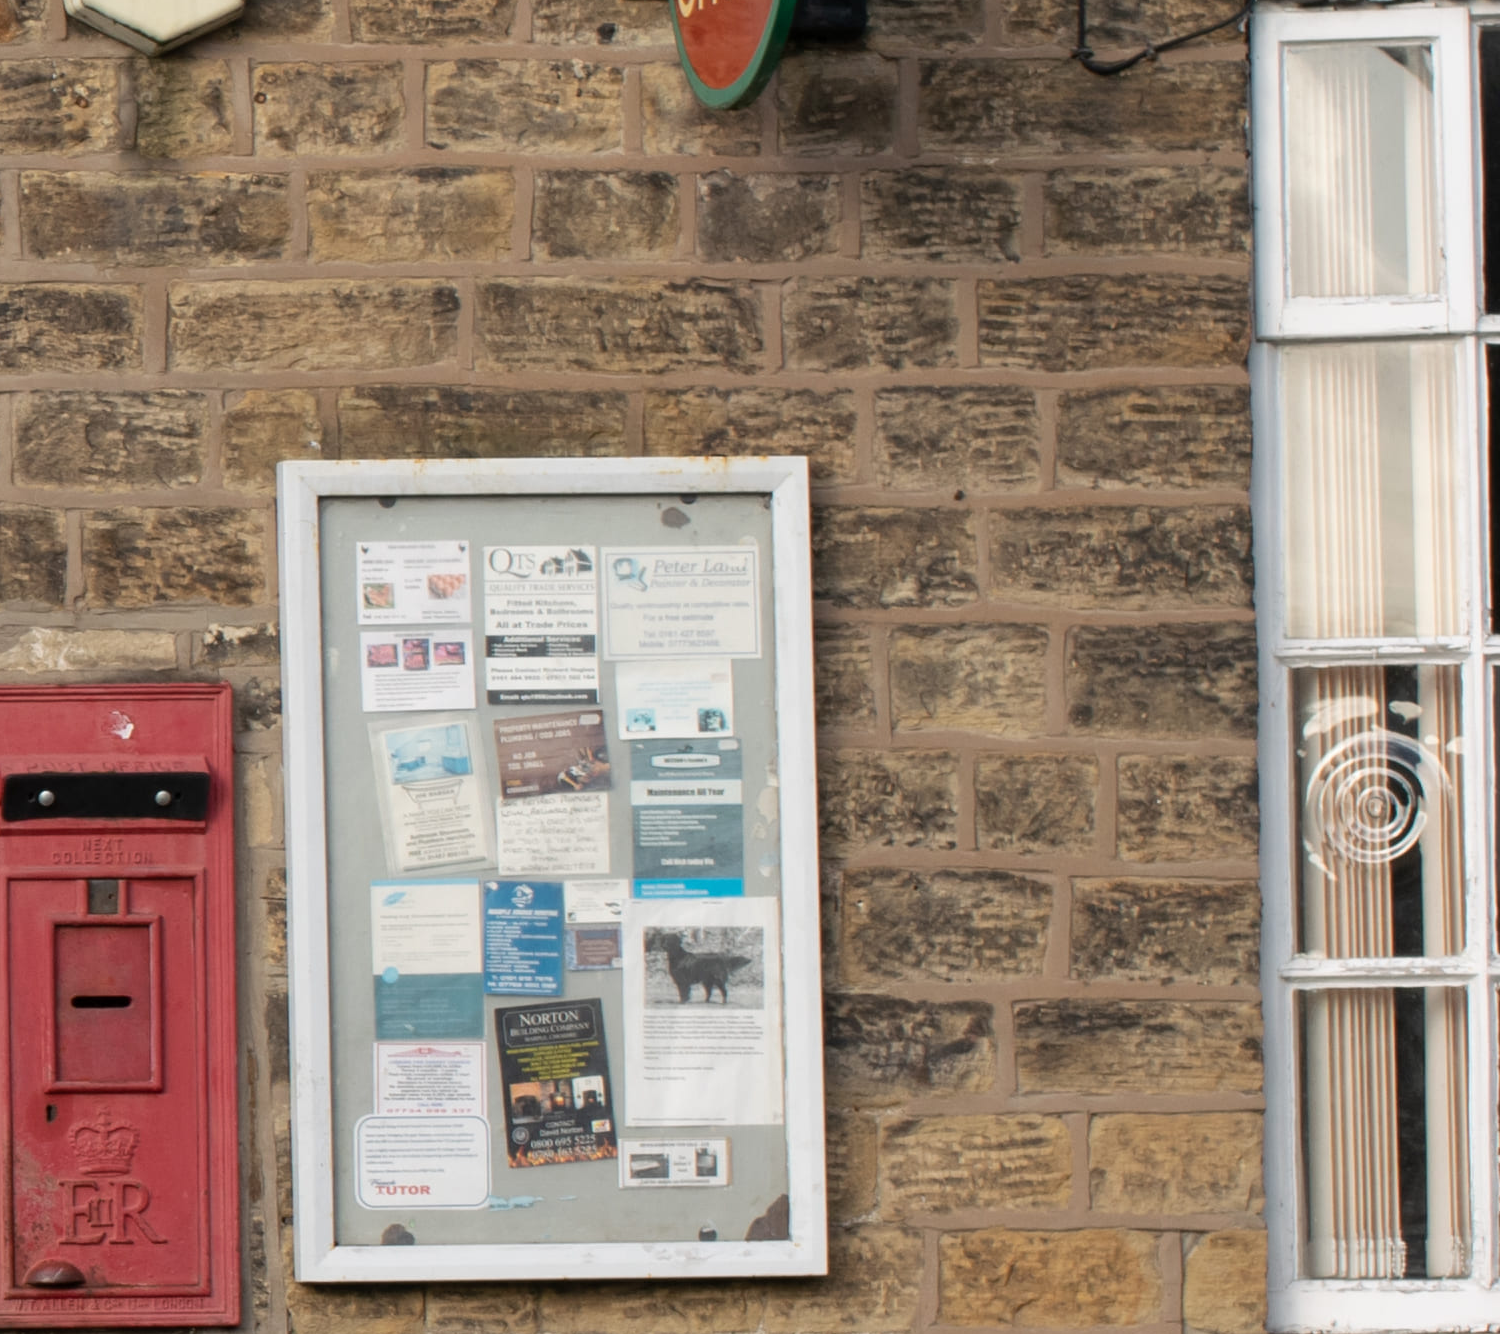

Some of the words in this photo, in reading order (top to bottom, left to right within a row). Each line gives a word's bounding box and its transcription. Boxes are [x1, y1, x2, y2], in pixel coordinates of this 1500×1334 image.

[489, 548, 537, 578] QTS
[653, 559, 696, 574] Peter
[82, 838, 124, 852] NEXT
[52, 852, 155, 866] COLLECTION
[519, 1010, 580, 1028] NORTON
[375, 1185, 431, 1196] TUTOR
